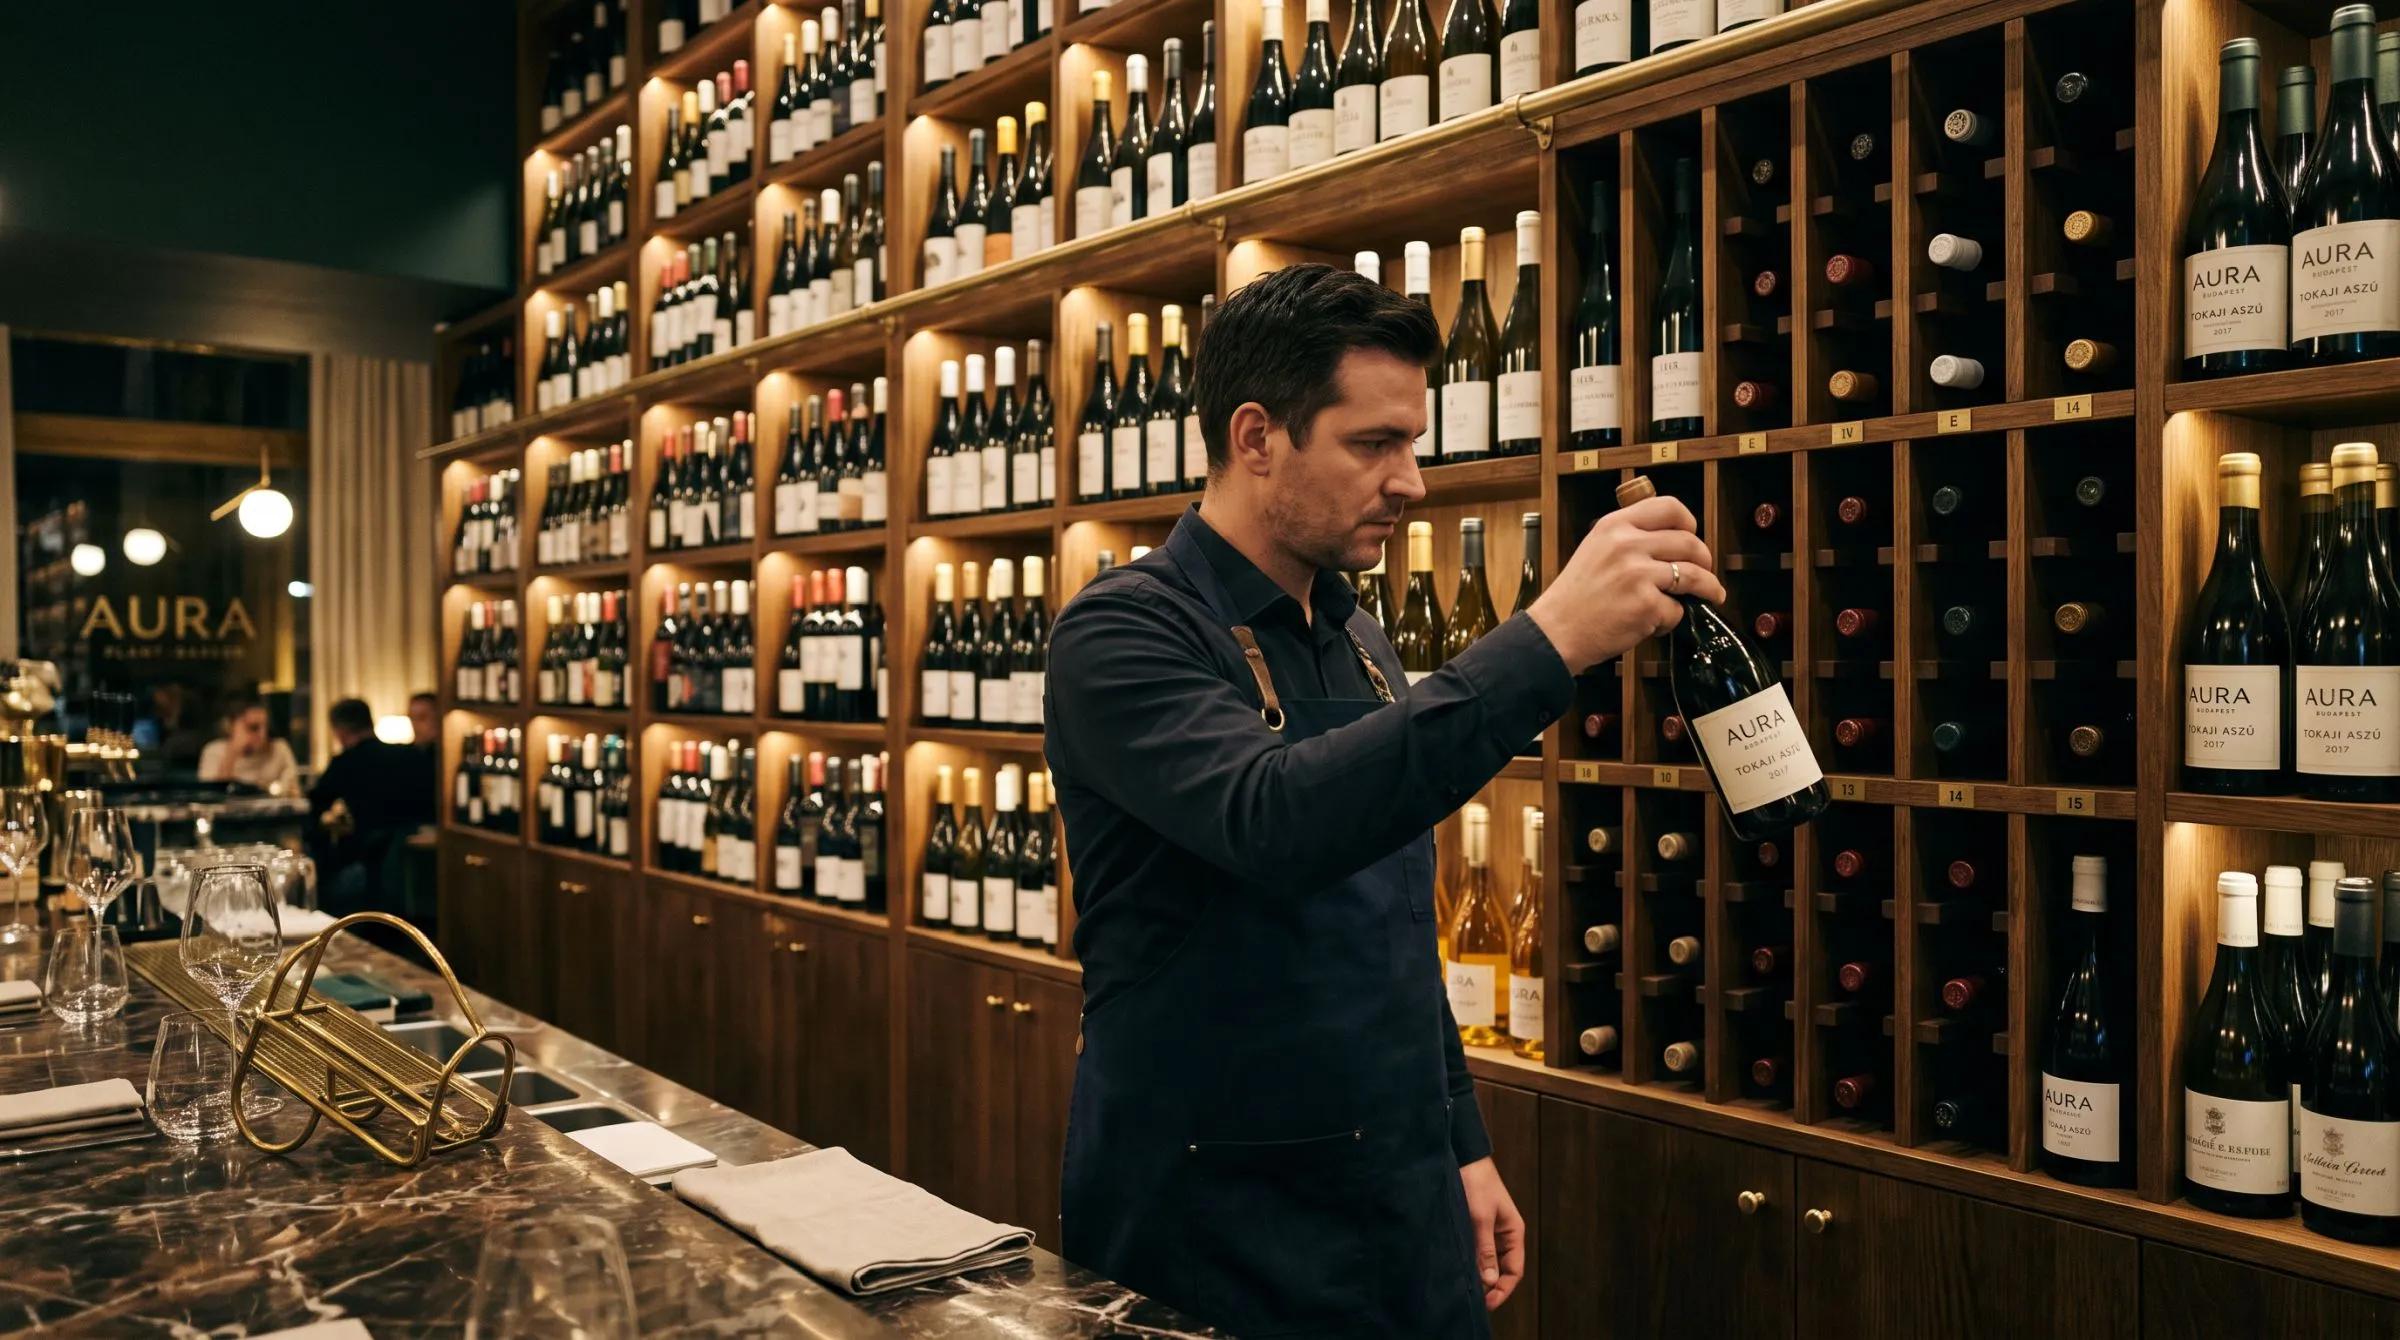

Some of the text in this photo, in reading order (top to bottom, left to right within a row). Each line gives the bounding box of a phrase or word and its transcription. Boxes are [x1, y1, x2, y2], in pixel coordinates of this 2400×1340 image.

[2302, 241, 2374, 269] AURA
[2193, 264, 2261, 292] AURA
[2300, 287, 2338, 303] TOKAJI
[2191, 308, 2226, 321] TOKAJI
[2324, 308, 2345, 318] 2017
[2213, 327, 2232, 336] 2017
[2066, 401, 2080, 414] 14
[1950, 415, 1958, 427] E
[1749, 438, 1756, 449] E
[1661, 446, 1668, 458] E
[80, 595, 257, 639] AURA
[2189, 686, 2251, 705] AURA
[2305, 688, 2378, 707] AURA
[1727, 709, 1786, 747] AURA
[2188, 725, 2218, 735] TOKAJI
[2304, 729, 2341, 739] TOKAJI
[2203, 740, 2225, 748] 2017
[2325, 745, 2350, 753] 2017
[1735, 755, 1776, 776] TOKAJI
[1842, 784, 1855, 796] 13
[1949, 790, 1963, 803] 14
[2067, 797, 2083, 810] 15
[2045, 1088, 2093, 1112] AURA
